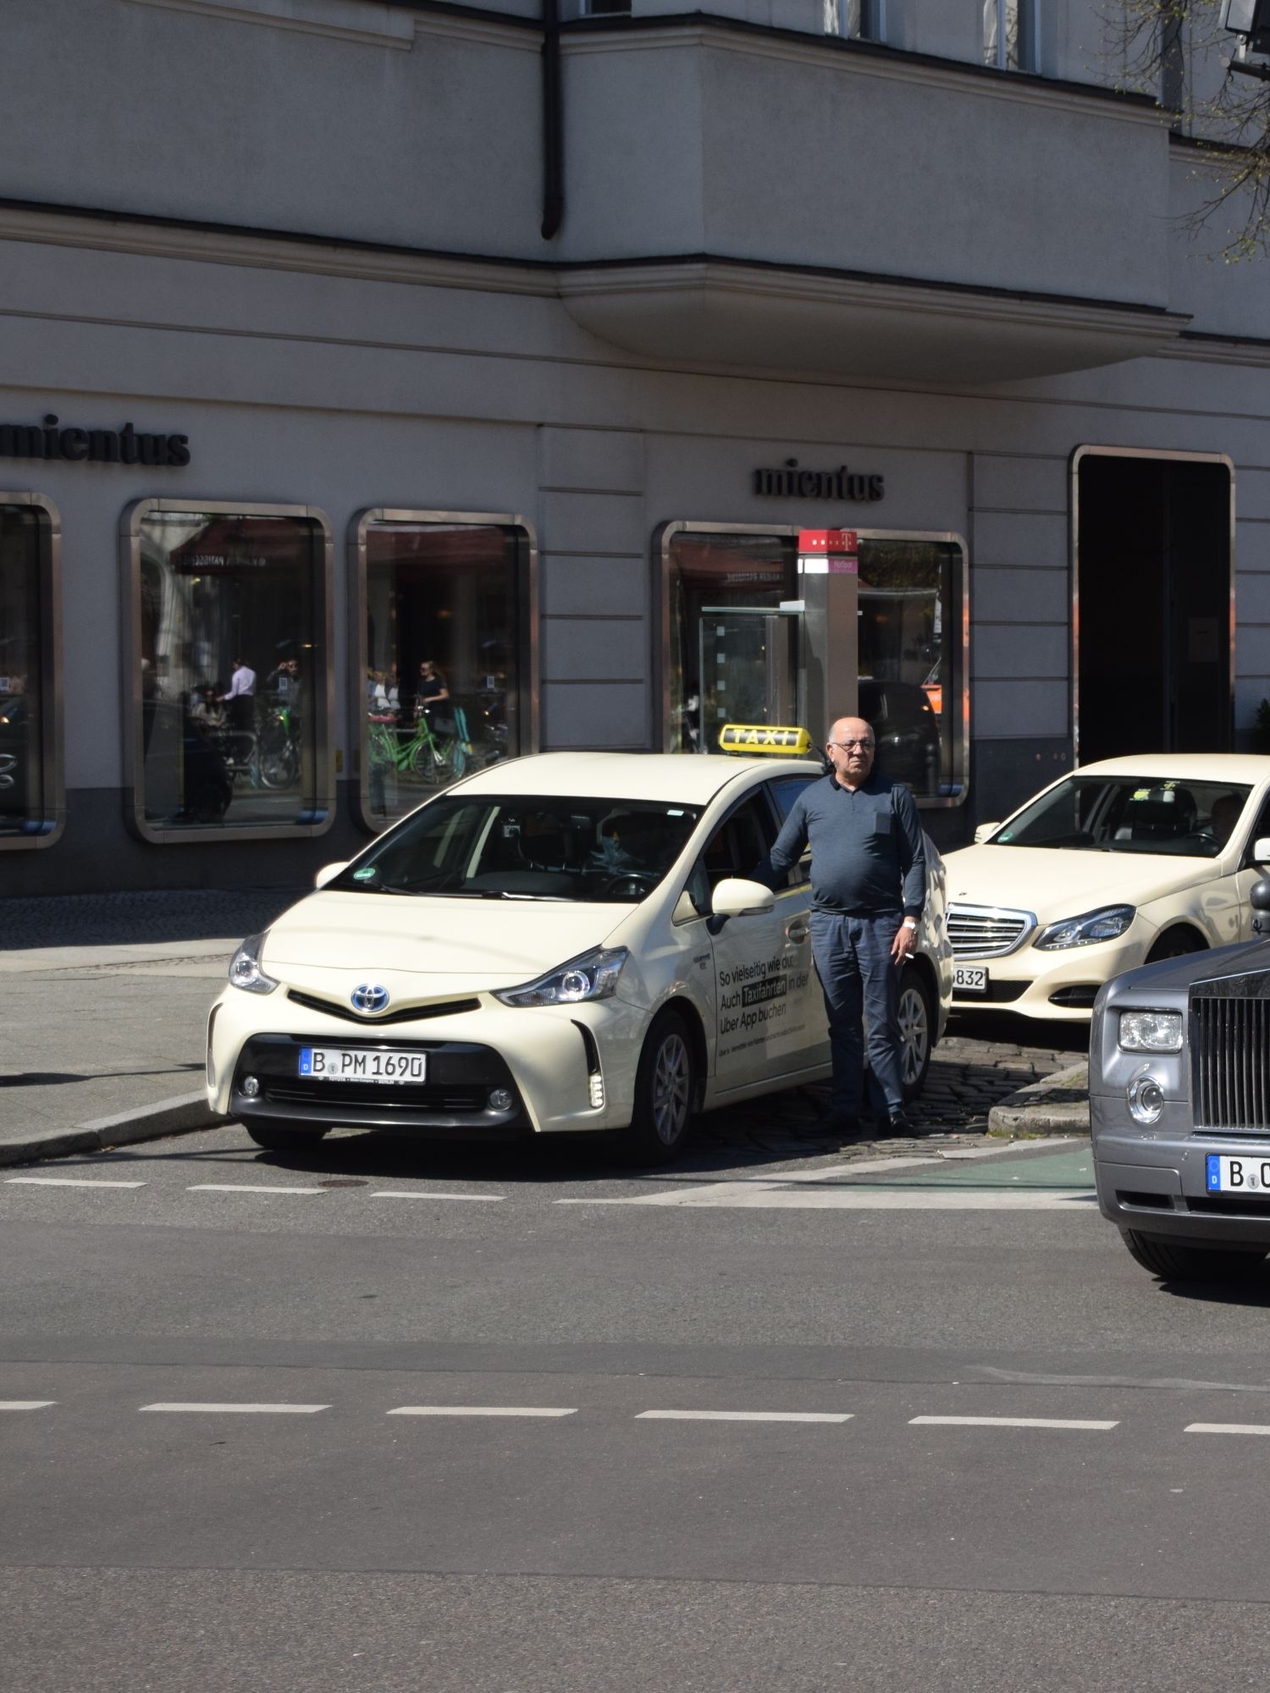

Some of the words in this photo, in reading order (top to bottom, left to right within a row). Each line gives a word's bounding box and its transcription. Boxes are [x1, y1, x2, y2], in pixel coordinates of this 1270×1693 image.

[0, 414, 191, 467] mientus
[753, 458, 885, 501] mientus
[733, 729, 789, 746] TAXI
[720, 971, 730, 987] So
[731, 961, 766, 984] vielseitig
[768, 956, 781, 972] wie
[720, 991, 741, 1011] Auch
[744, 979, 787, 1003] Taxifahrten
[789, 975, 796, 989] in
[797, 973, 809, 987] der
[740, 1012, 758, 1031] App
[759, 1002, 787, 1022] buchen
[313, 1052, 326, 1073] B
[341, 1053, 367, 1075] PM
[372, 1055, 423, 1077] 1690
[1211, 1175, 1218, 1185] D
[1230, 1161, 1244, 1187] B
